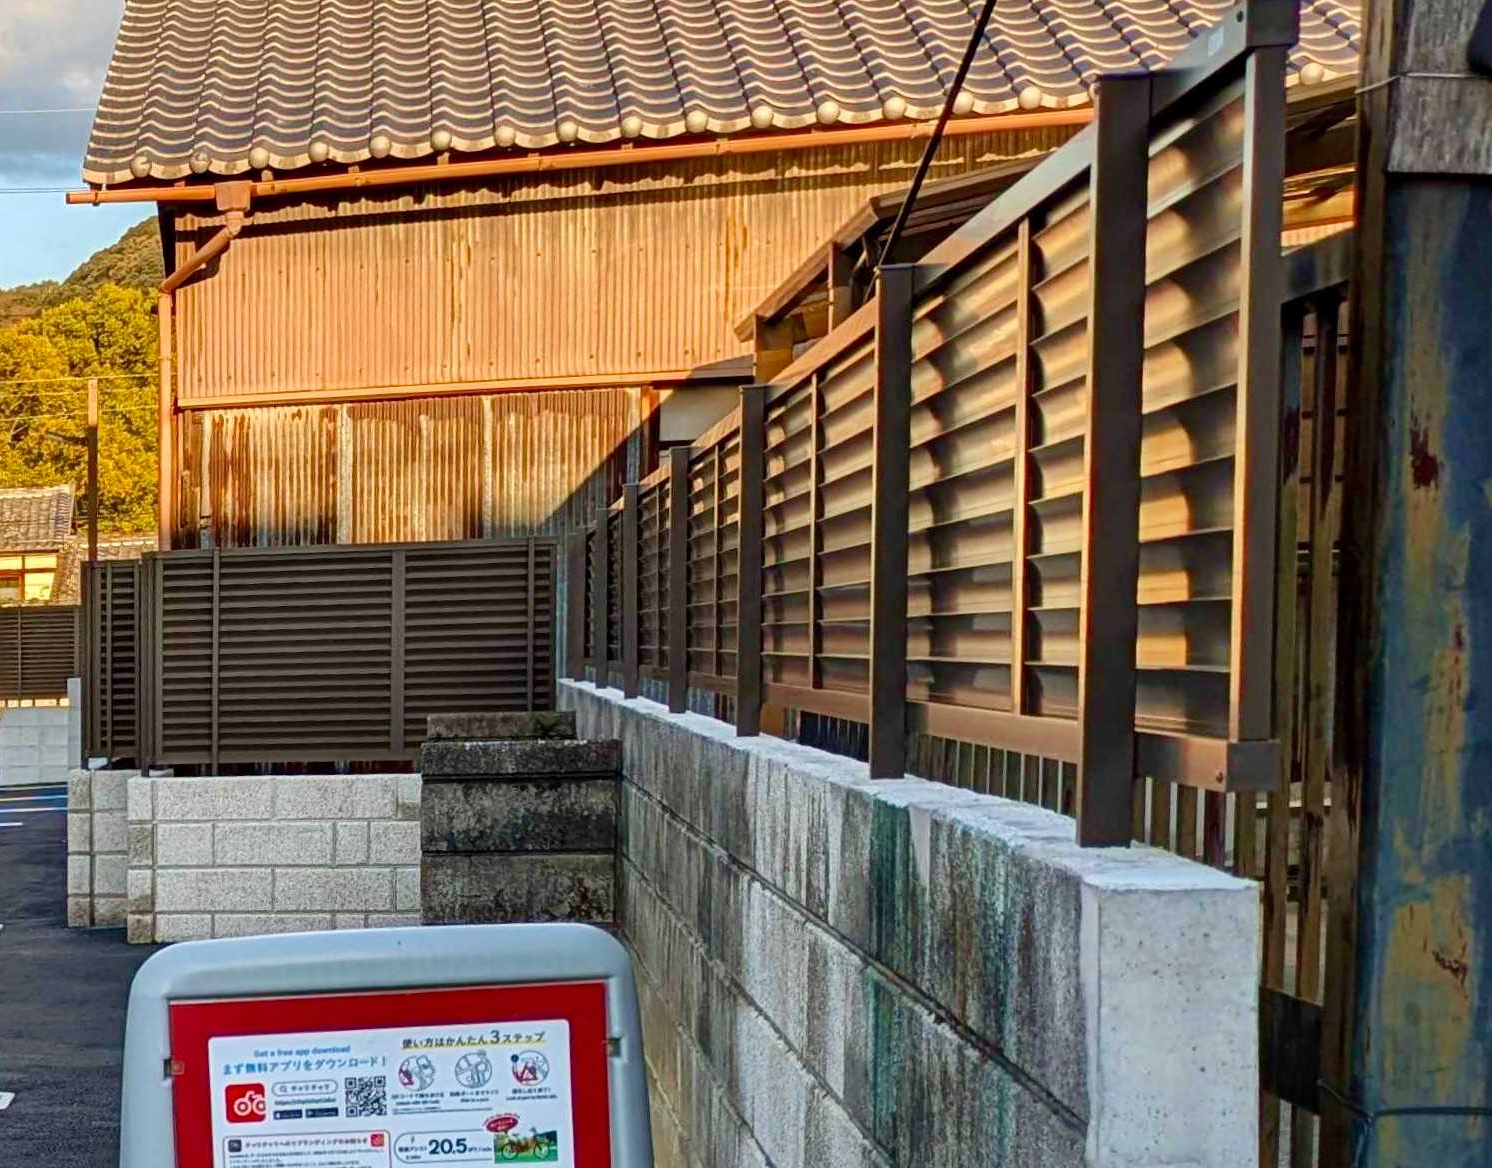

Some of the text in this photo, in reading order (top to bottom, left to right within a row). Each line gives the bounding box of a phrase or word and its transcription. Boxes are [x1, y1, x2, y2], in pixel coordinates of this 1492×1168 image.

[402, 1030, 545, 1049] 使い方はかんたん3ステップ
[277, 1048, 293, 1056] free
[296, 1048, 310, 1057] app
[311, 1045, 351, 1054] download
[429, 1138, 467, 1155] 20.5
